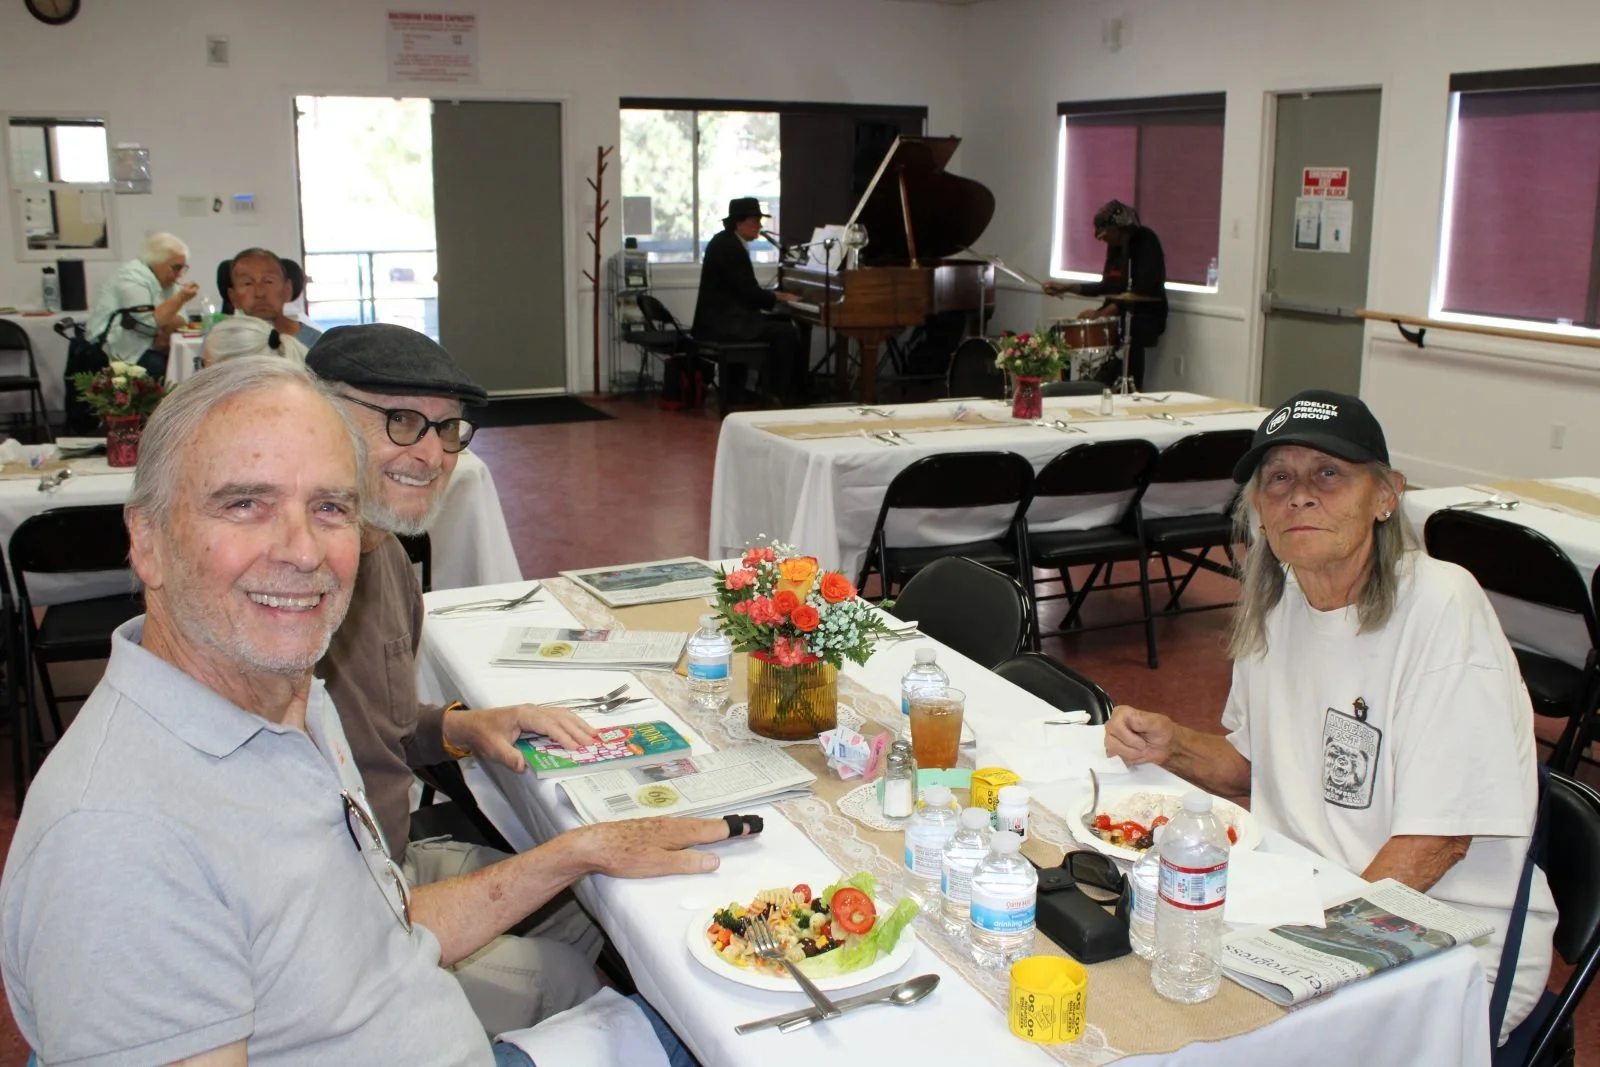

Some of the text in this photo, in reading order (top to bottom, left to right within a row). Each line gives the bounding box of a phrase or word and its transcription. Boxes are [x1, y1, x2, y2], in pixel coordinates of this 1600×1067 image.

[1295, 400, 1338, 411] FIDELITY
[1292, 412, 1330, 421] GROUP
[1293, 406, 1338, 417] PREMIER
[993, 919, 1023, 929] drinking
[1224, 944, 1299, 977] Progress
[1027, 994, 1035, 1037] 50/50
